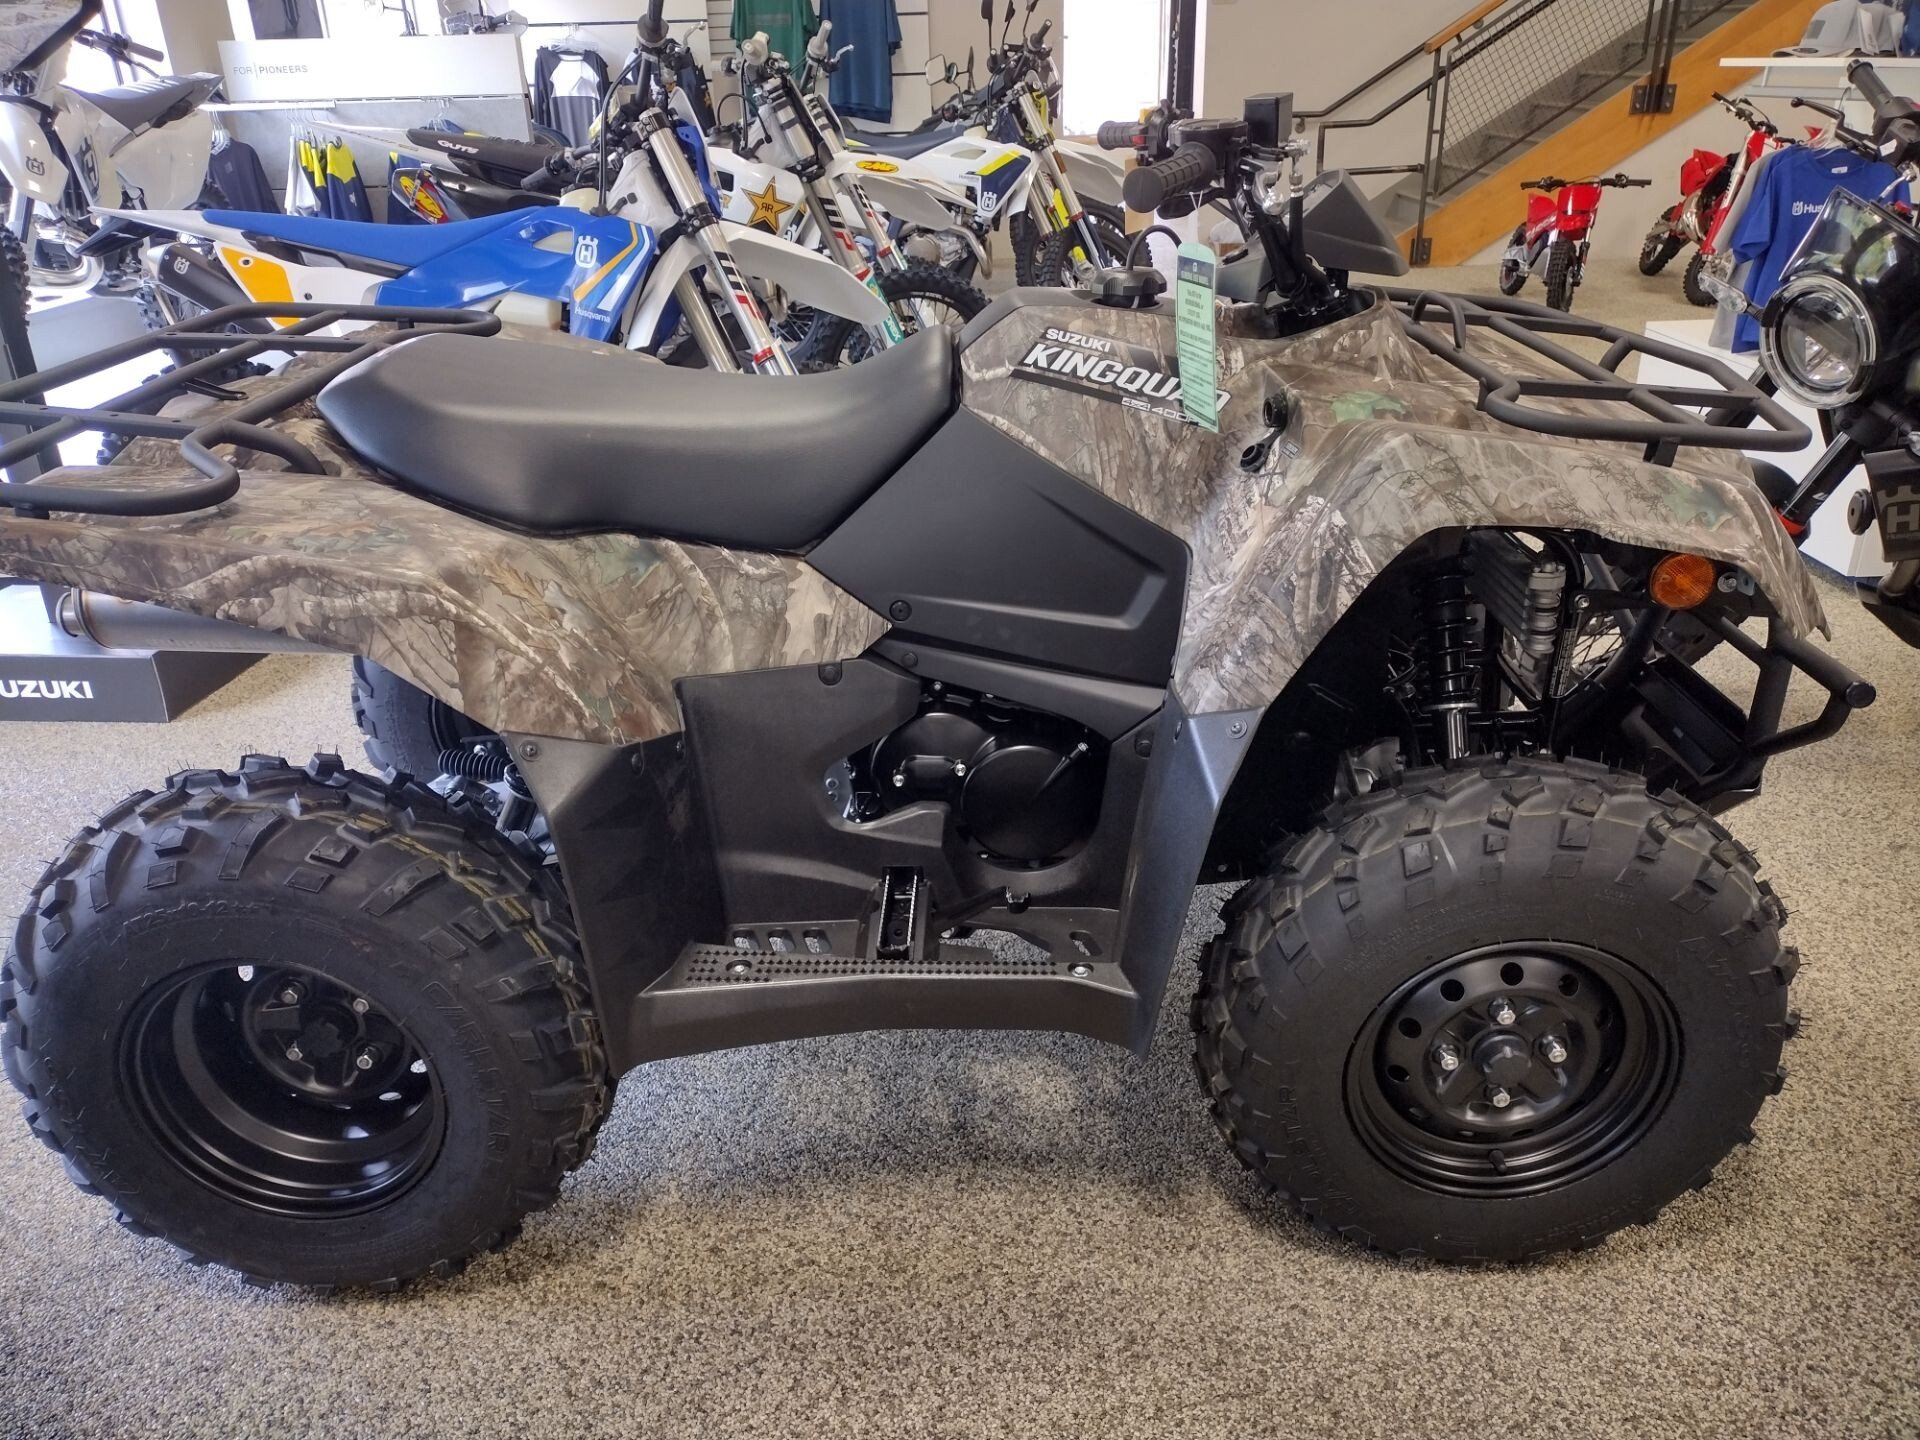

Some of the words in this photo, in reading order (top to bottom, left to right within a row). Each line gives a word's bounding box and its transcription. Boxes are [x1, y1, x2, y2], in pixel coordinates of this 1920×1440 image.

[233, 66, 253, 75] FOR
[258, 64, 309, 74] PIONEERS
[437, 139, 479, 154] GUTS
[574, 306, 611, 323] Husqvarna
[1045, 328, 1111, 353] SUZUKI
